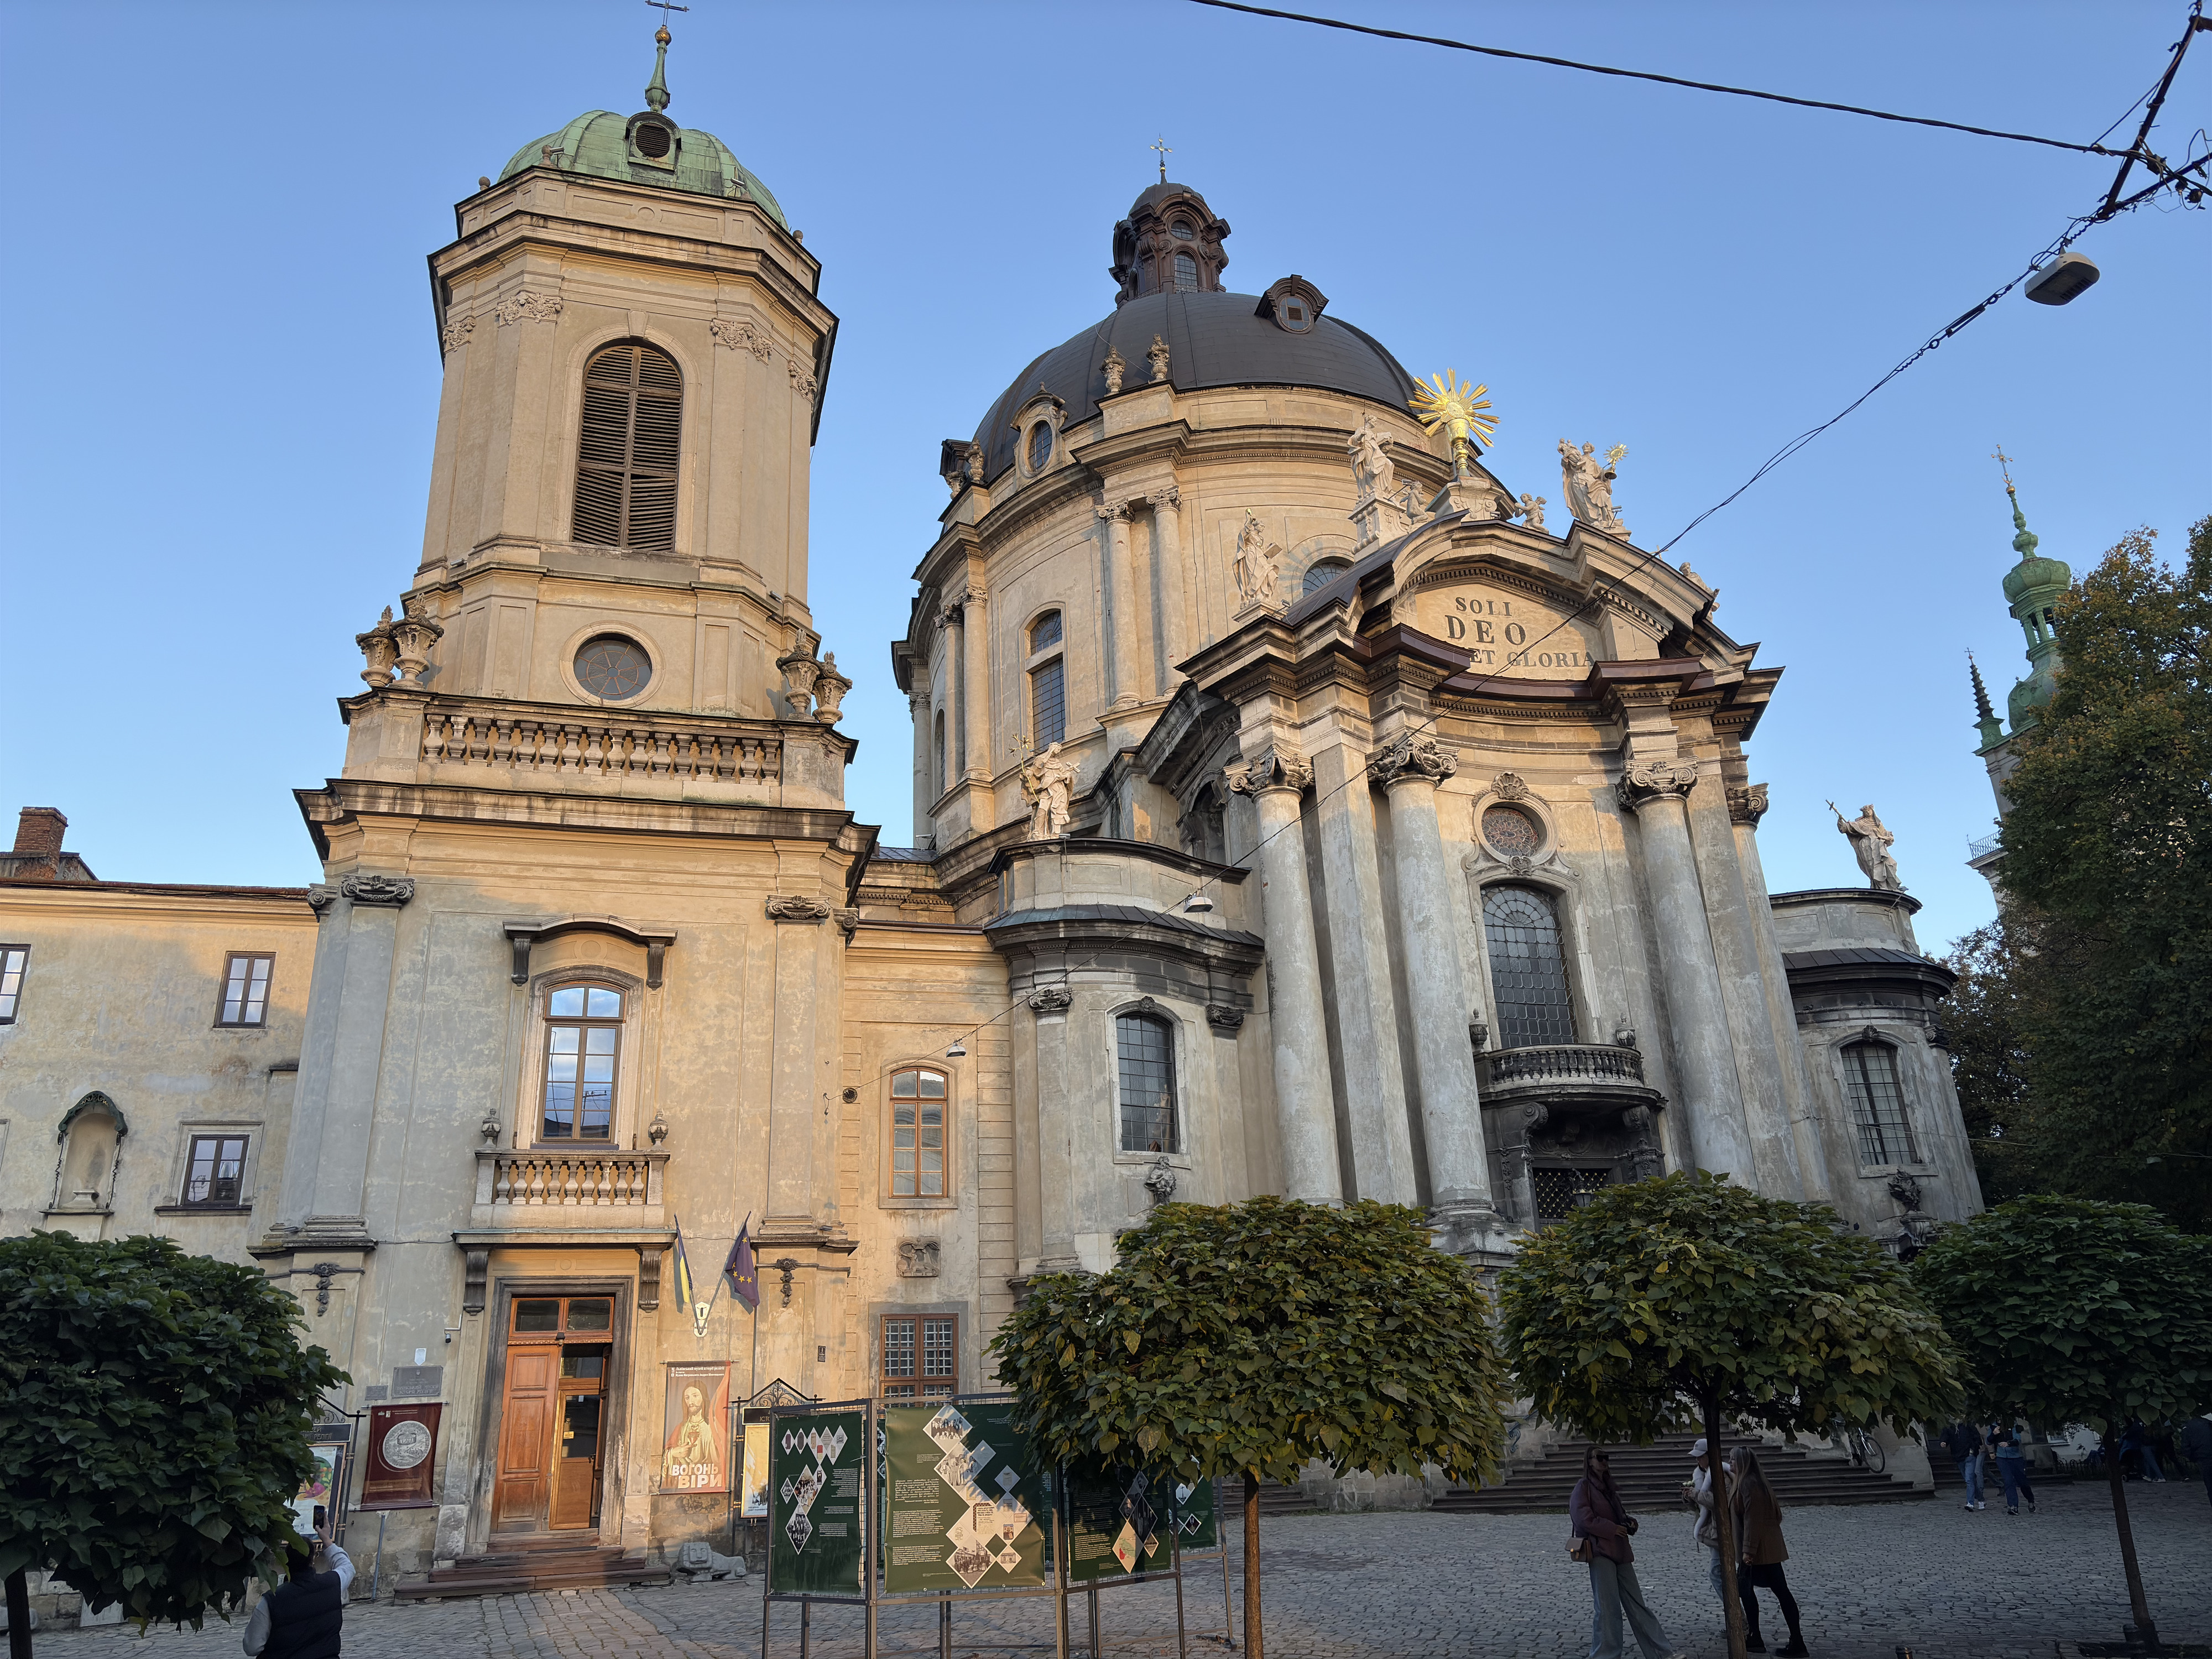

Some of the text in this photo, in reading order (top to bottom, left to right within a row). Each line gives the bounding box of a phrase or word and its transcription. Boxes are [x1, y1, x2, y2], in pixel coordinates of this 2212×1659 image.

[1455, 597, 1512, 617] SOLI
[1444, 615, 1526, 645] DEO
[1468, 647, 1595, 667] ET GLORIA
[672, 1463, 719, 1476] ВОГОНЬ
[677, 1474, 722, 1489] ВІРИ
